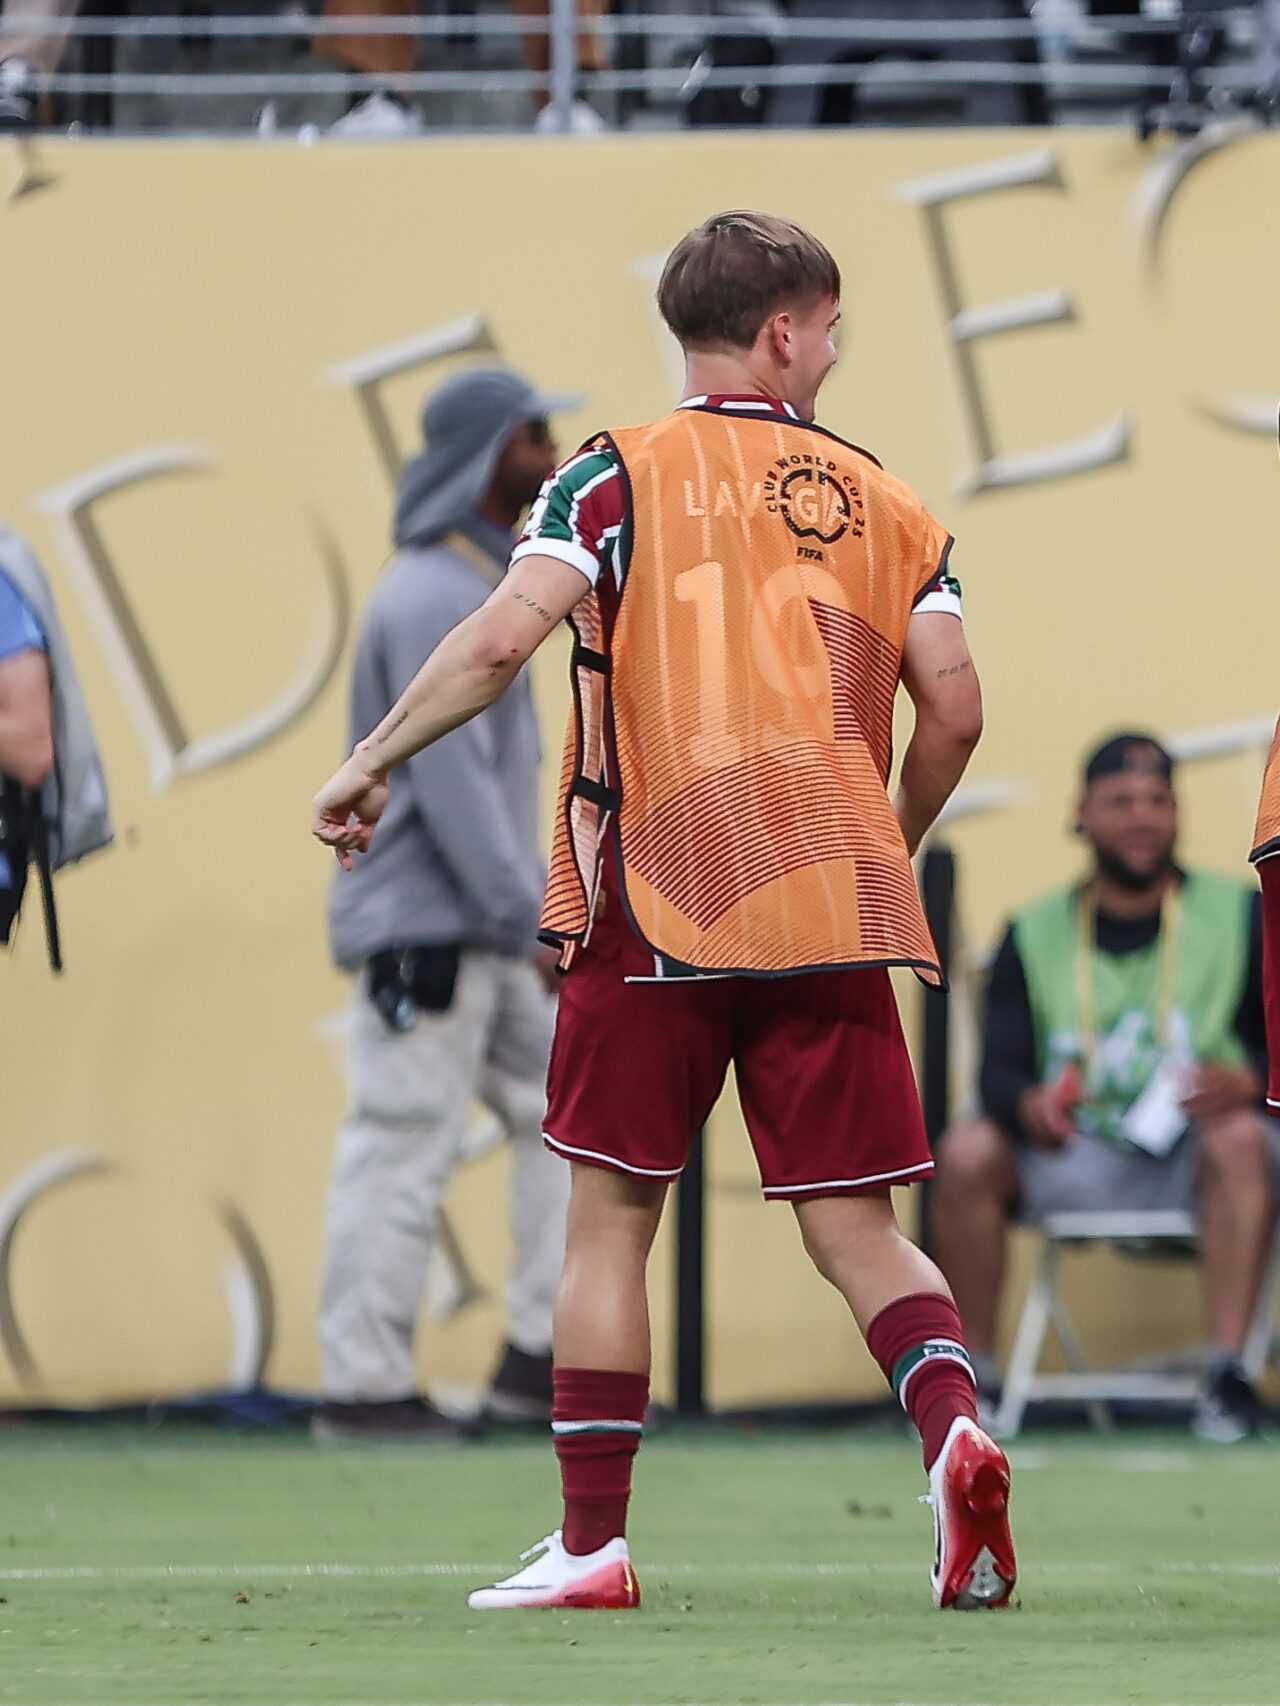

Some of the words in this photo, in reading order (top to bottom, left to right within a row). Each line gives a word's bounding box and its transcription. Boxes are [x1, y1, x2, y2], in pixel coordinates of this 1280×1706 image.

[774, 454, 837, 472] WORLD
[683, 480, 850, 527] LAVGA
[763, 471, 778, 514] CLUB
[842, 475, 864, 509] CUP
[851, 519, 866, 539] 25
[796, 546, 825, 562] FIFA
[673, 561, 858, 770] 19
